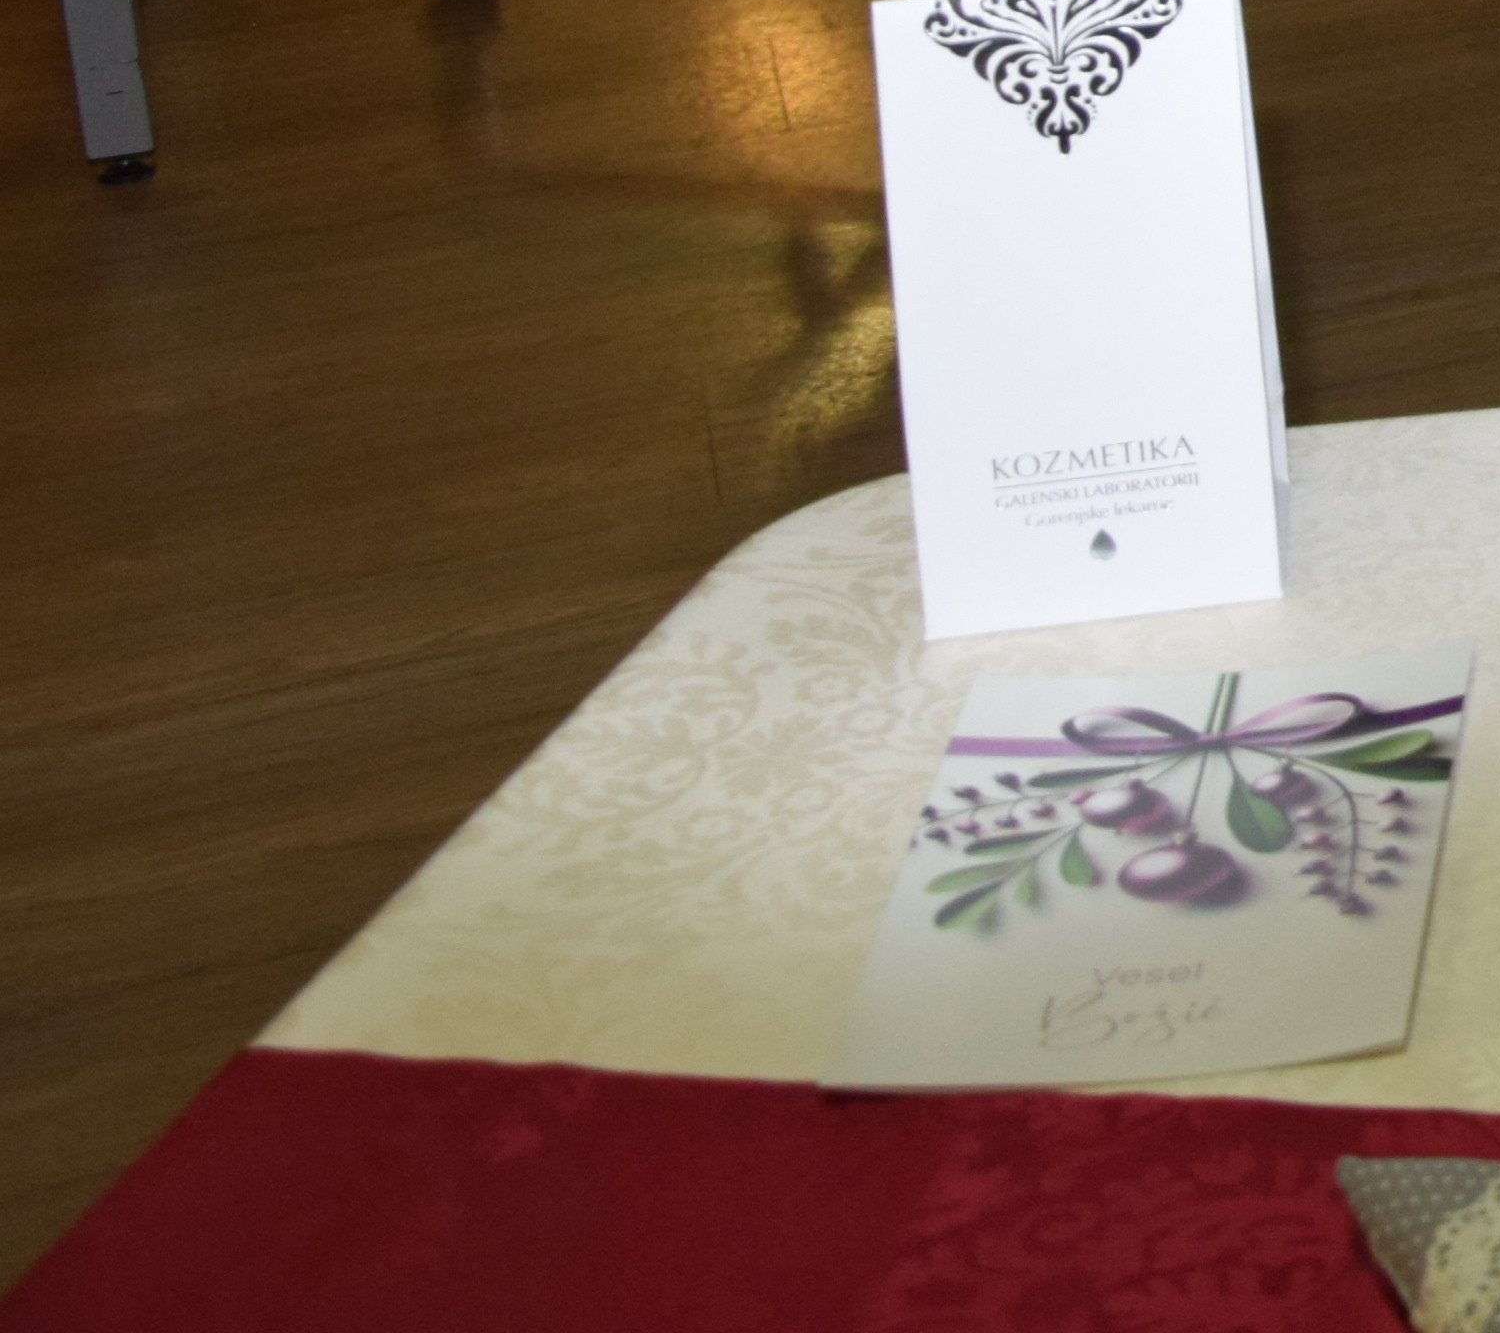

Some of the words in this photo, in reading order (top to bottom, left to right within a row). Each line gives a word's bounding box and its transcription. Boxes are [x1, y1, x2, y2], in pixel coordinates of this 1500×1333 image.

[991, 434, 1195, 481] KOZMETIKA
[994, 486, 1080, 510] GALENSKI
[1083, 471, 1200, 499] LABORATORIJ
